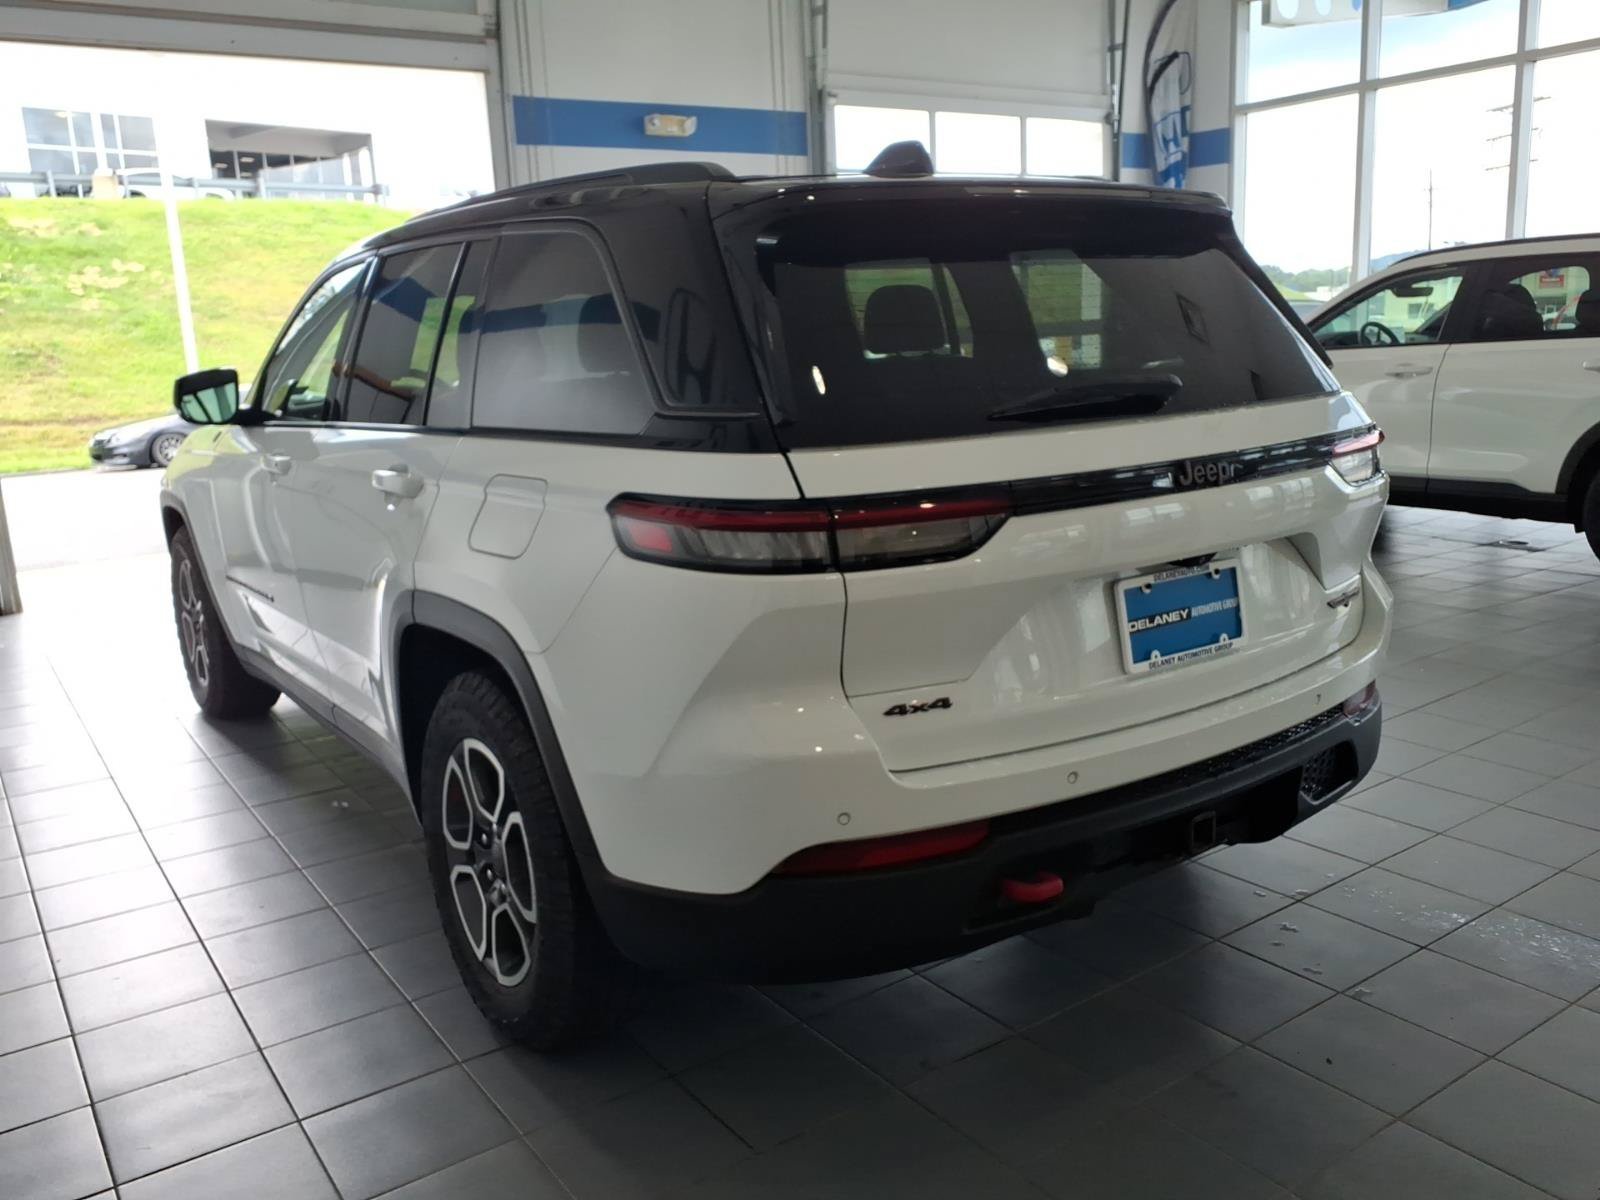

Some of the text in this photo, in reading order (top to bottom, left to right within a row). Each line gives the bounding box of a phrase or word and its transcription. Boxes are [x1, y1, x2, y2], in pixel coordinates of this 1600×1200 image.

[1179, 460, 1230, 486] Jeep
[1128, 608, 1190, 632] DELANEY
[1149, 642, 1233, 670] DELANEY AUTOMOTIVE GROUP
